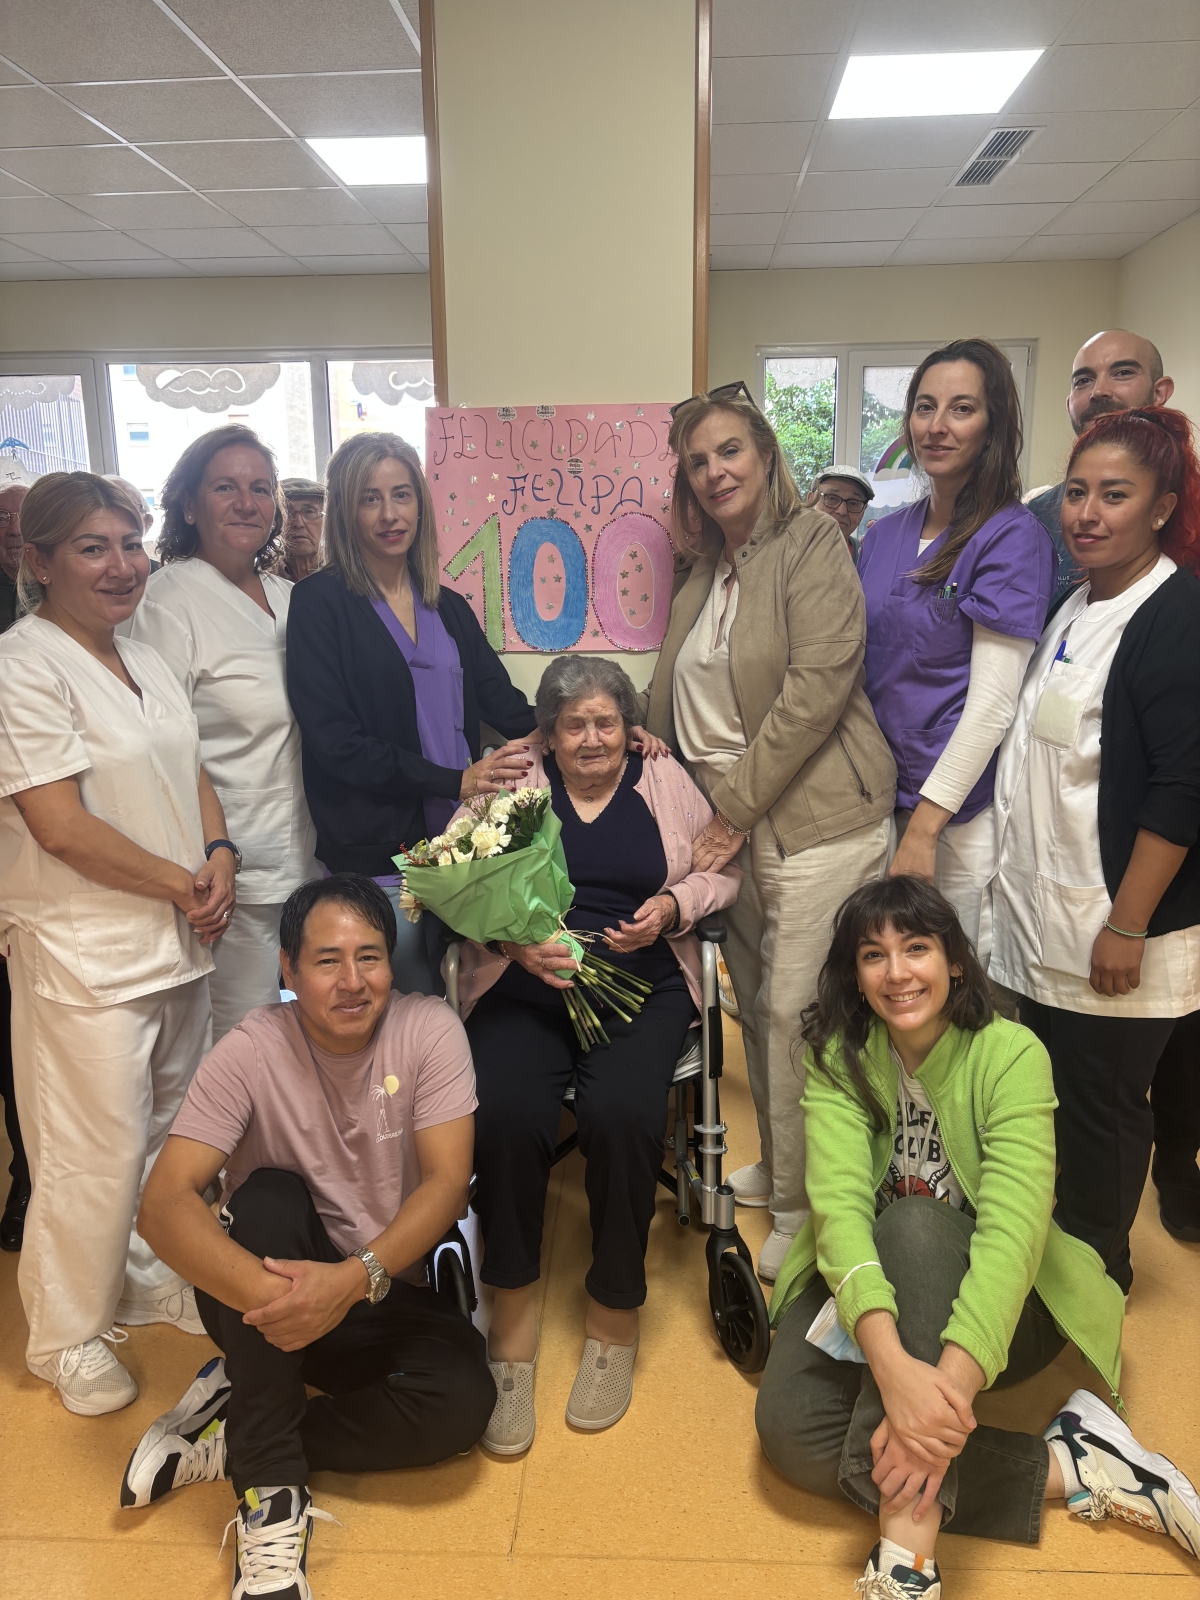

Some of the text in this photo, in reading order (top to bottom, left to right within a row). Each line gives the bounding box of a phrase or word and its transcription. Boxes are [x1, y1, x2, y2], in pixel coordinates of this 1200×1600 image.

[434, 413, 680, 466] FELICIDADE
[501, 468, 644, 516] FELIPA
[443, 511, 676, 653] 100
